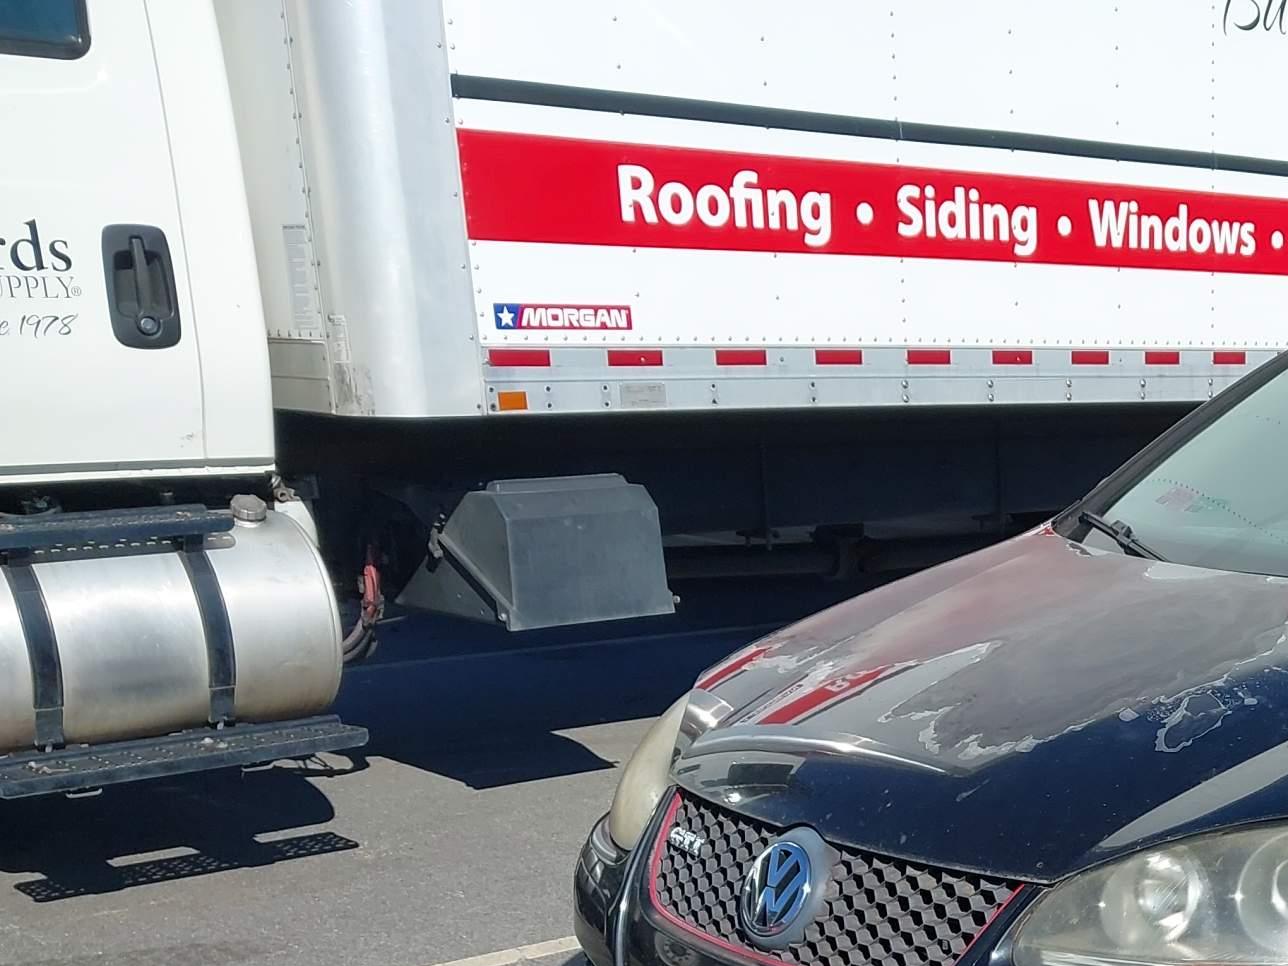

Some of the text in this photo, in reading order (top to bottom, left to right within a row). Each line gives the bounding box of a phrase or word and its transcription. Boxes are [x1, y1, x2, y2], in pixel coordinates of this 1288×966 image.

[616, 163, 832, 247] Roofing
[896, 184, 1038, 256] Siding
[1087, 198, 1256, 257] Windows
[19, 314, 79, 339] 1978
[521, 306, 628, 329] MORGAN
